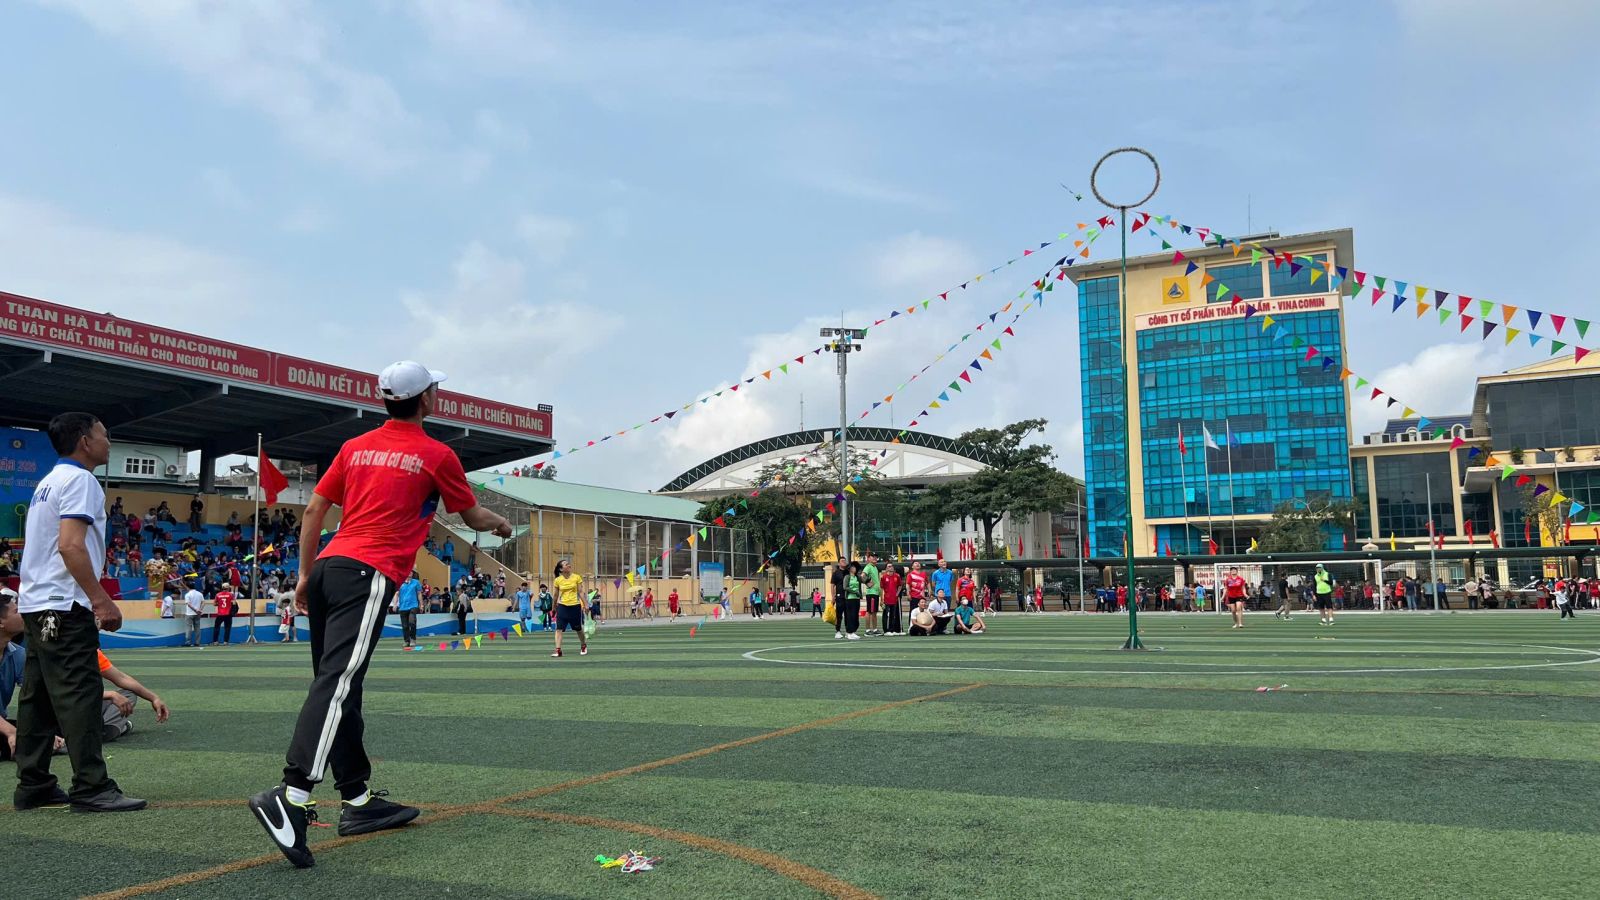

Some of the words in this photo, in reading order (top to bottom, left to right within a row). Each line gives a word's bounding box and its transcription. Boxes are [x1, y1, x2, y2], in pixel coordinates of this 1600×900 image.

[6, 302, 58, 323] THAN
[64, 315, 89, 329] HÀ
[149, 332, 238, 360] VINACOMIN
[1148, 314, 1168, 326] CÔNG
[1170, 313, 1178, 322] TY
[1181, 309, 1191, 321] CỔ
[1216, 304, 1237, 316] THAN
[1277, 298, 1325, 310] VINACOMIN
[22, 321, 46, 336] VẬT
[49, 327, 83, 345] CHẤT,
[88, 335, 115, 350] TINH
[152, 348, 173, 361] CHO
[176, 353, 208, 368] NGƯỜI
[211, 360, 229, 372] LAO
[232, 363, 259, 378] ĐỘNG
[288, 366, 326, 389] ĐOÀN
[329, 373, 353, 394] KẾT
[356, 379, 371, 398] LÀ
[438, 398, 457, 416] TẠO
[462, 402, 482, 419] NÊN
[484, 407, 512, 425] CHIẾN
[515, 411, 543, 431] THẮNG
[361, 450, 375, 465] CƠ
[372, 449, 390, 466] KHÍ
[387, 452, 403, 468] CƠ
[221, 598, 227, 608] 3
